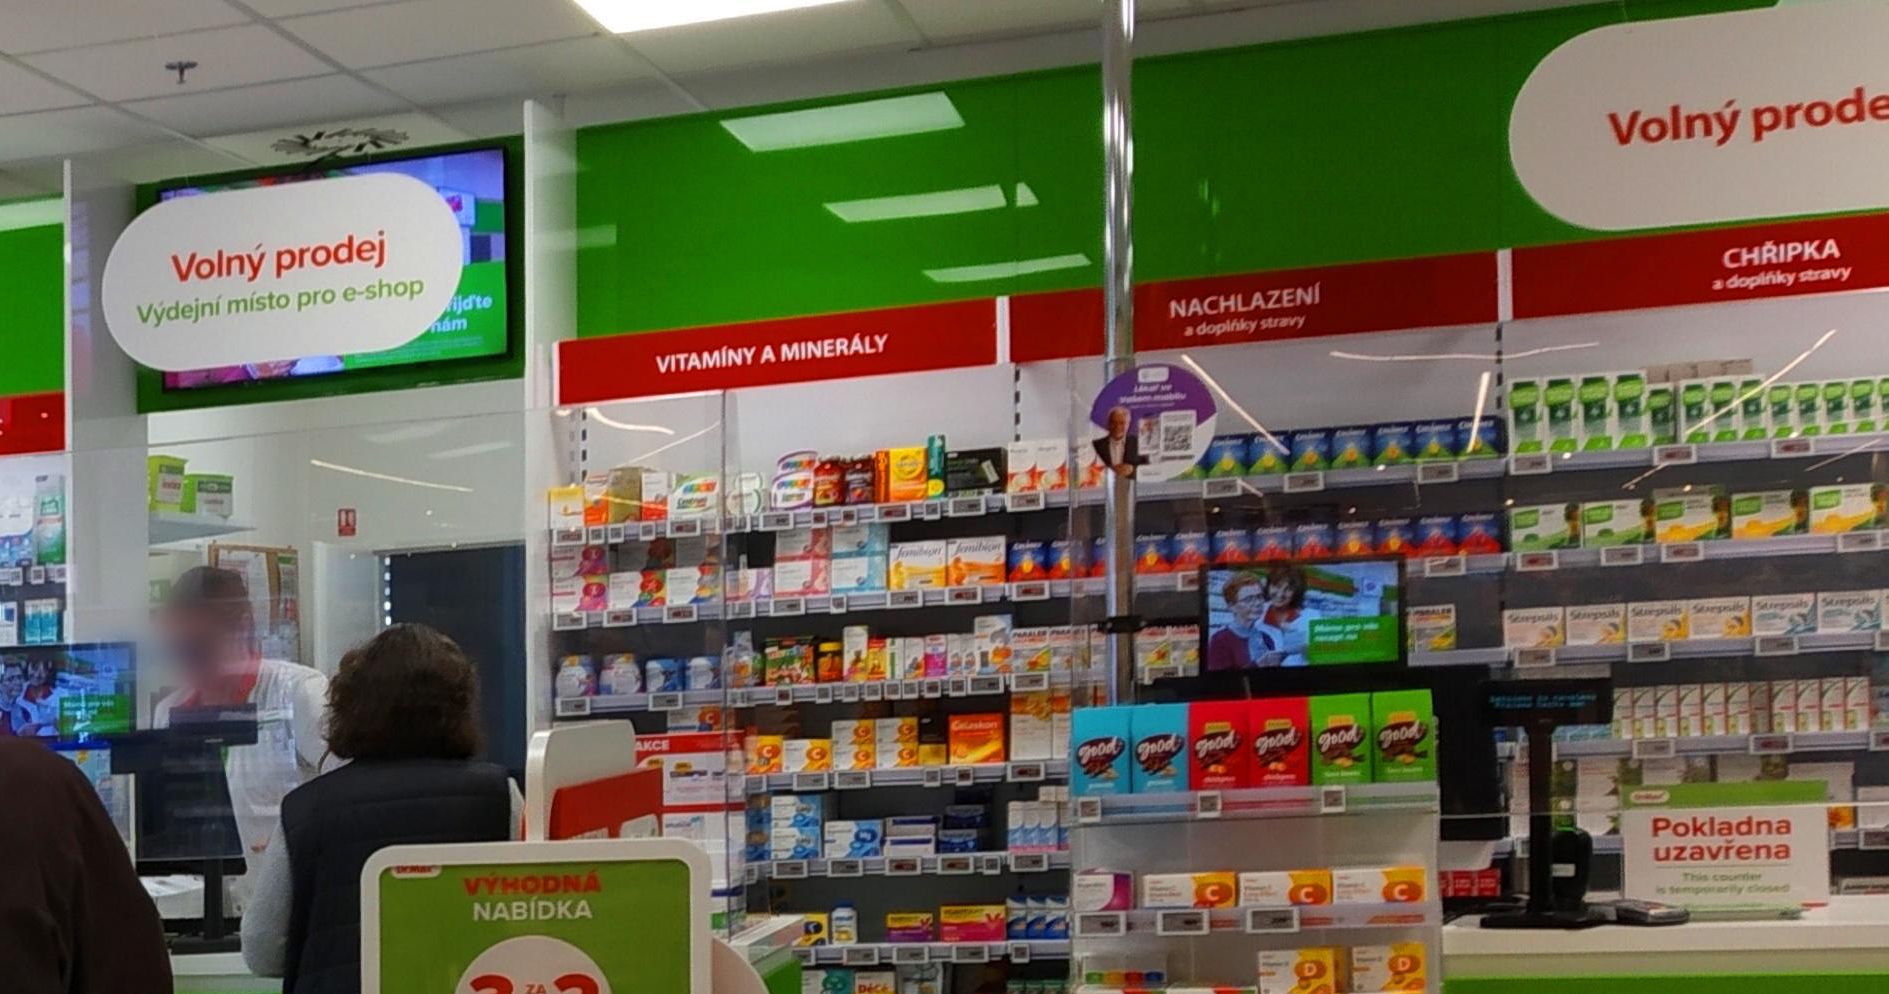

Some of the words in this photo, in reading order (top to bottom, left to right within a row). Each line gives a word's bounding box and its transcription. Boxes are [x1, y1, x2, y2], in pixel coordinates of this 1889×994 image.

[1607, 99, 1742, 147] Volný
[170, 244, 268, 283] Volný
[275, 230, 387, 278] prodej
[1722, 238, 1842, 269] CHŘIPKA
[1712, 279, 1724, 290] a
[1726, 271, 1796, 290] doplňky
[1799, 266, 1852, 282] stravy
[136, 292, 221, 328] Výdejní
[227, 289, 291, 315] místo
[297, 289, 336, 313] pro
[342, 278, 426, 303] e-shop
[1169, 281, 1322, 319] NACHLAZENÍ
[431, 317, 468, 333] nám
[1183, 326, 1194, 337] a
[1196, 319, 1257, 337] doplňky
[1260, 315, 1306, 329] stravy
[656, 345, 756, 374] VITAMÍNY
[760, 345, 776, 364] A
[781, 333, 889, 361] MINERÁLY
[1137, 734, 1179, 762] good
[1195, 733, 1237, 757] good
[1255, 729, 1296, 755] good
[1319, 725, 1361, 751] good
[1380, 722, 1423, 748] good
[1078, 737, 1121, 765] good
[1651, 815, 1792, 838] Pokladna
[1653, 839, 1791, 863] uzavřena
[463, 867, 602, 896] VÝHODNÁ
[1656, 884, 1666, 894] is
[1668, 883, 1744, 895] temporarily
[1747, 883, 1790, 894] closed
[1682, 872, 1709, 883] This
[1713, 872, 1762, 883] counter
[473, 896, 593, 922] NABÍDKA
